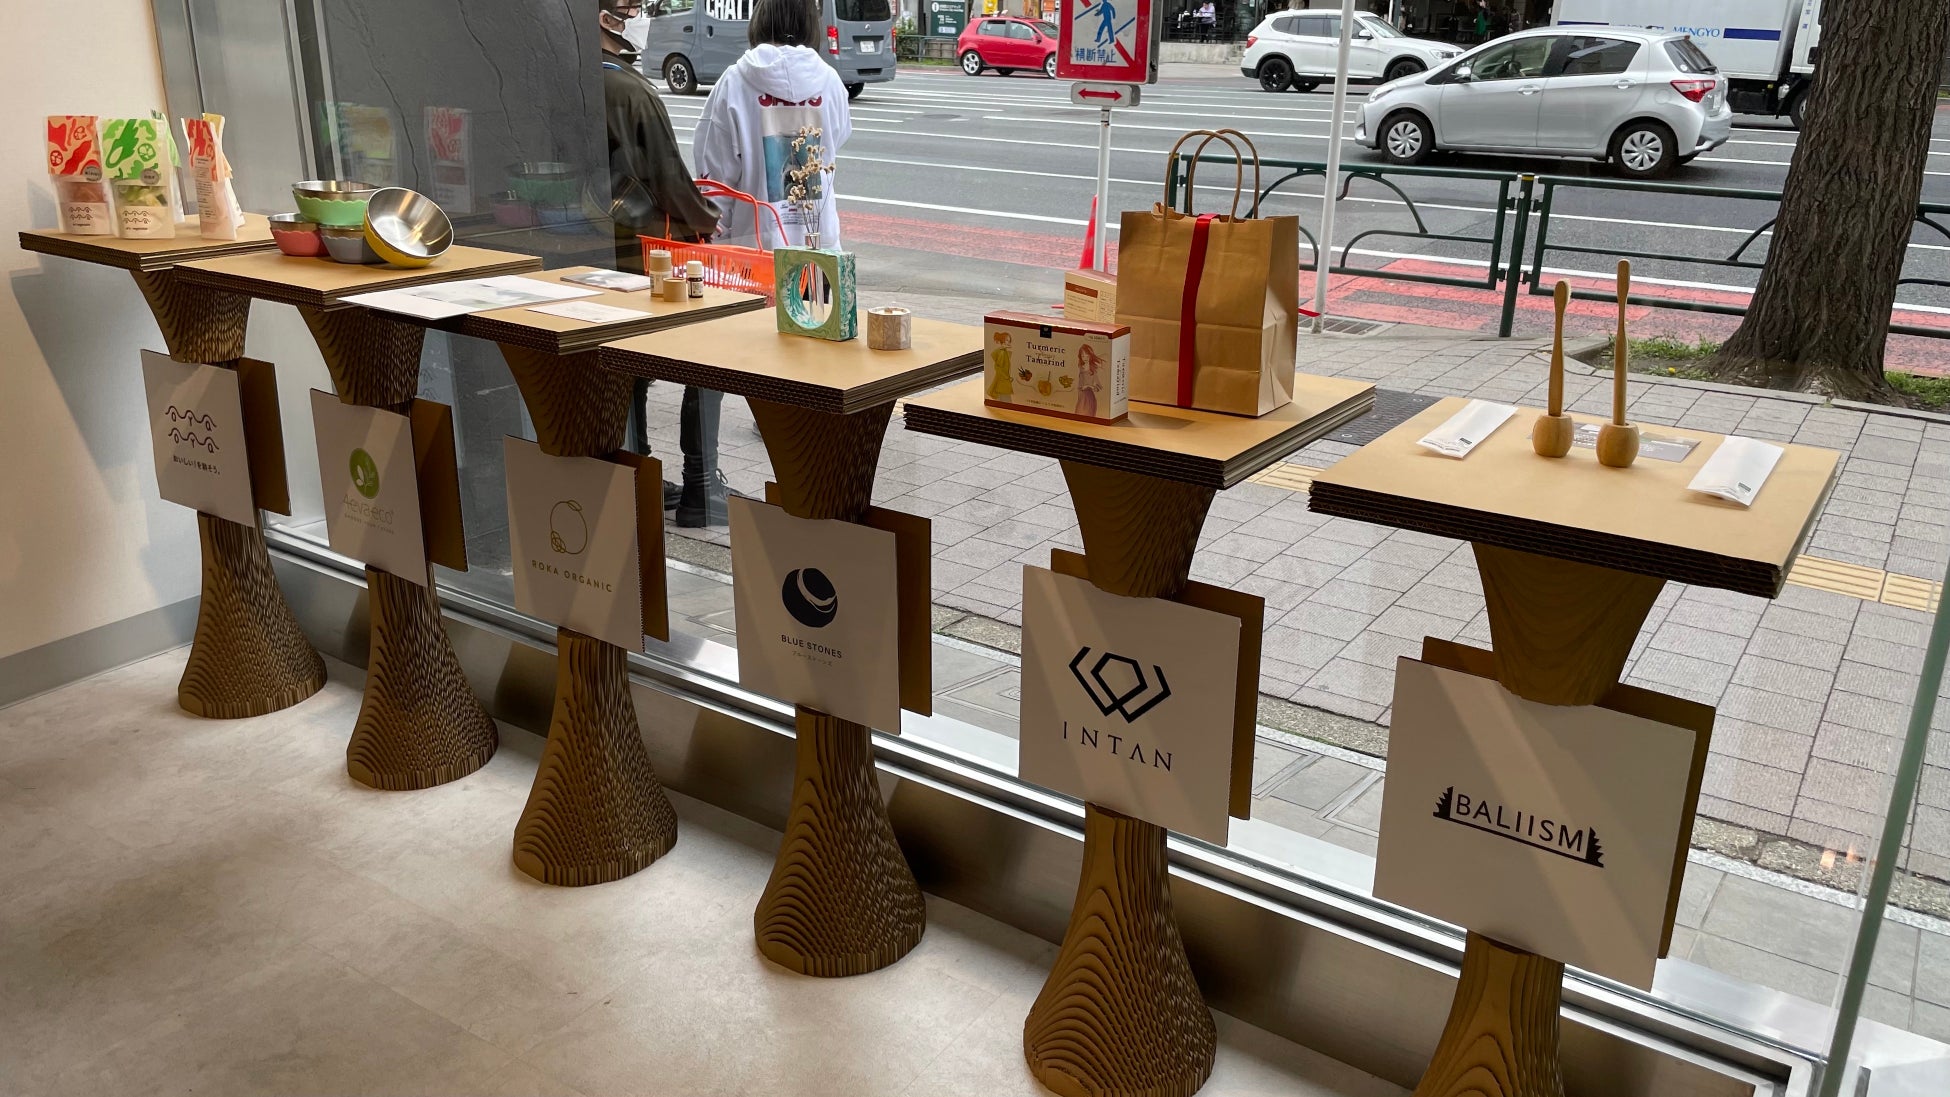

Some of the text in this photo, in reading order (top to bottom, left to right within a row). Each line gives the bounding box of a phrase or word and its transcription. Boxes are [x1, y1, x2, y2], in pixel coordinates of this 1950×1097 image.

[1672, 26, 1720, 38] MENGYO
[1075, 47, 1117, 63] 横断禁止
[1026, 341, 1066, 354] Turmeric
[1026, 354, 1065, 367] Tamarind
[531, 559, 612, 593] ROKA ORGANIC
[781, 634, 842, 659] BLUE STONES
[1063, 721, 1173, 772] INTAN
[1456, 793, 1583, 852] BALIISM
